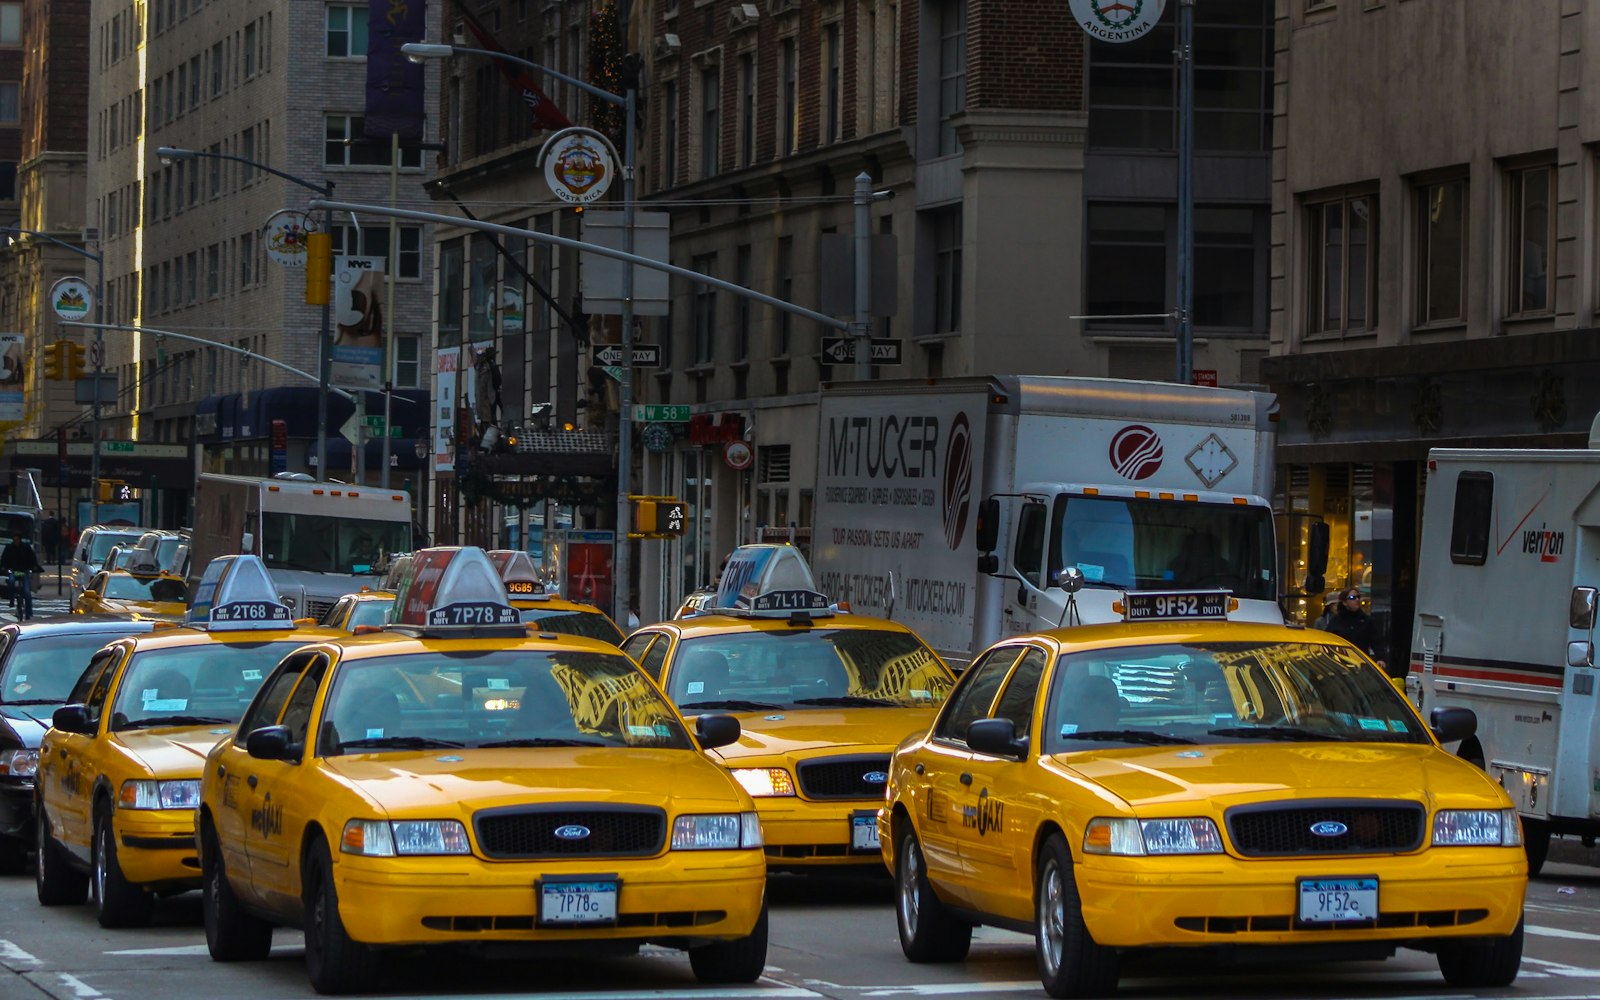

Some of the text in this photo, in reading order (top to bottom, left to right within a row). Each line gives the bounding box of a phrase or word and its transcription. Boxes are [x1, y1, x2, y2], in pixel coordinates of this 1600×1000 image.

[1083, 20, 1151, 40] ARGENTINA
[555, 188, 602, 202] COSTA RICA
[347, 260, 373, 268] NYC
[603, 352, 651, 360] ONE WAY
[833, 345, 856, 356] ONE
[646, 408, 656, 419] W
[662, 408, 678, 420] 58
[847, 528, 873, 547] PASSION
[874, 530, 890, 548] SETS
[891, 531, 901, 549] US
[1522, 522, 1565, 563] verizon
[509, 582, 533, 593] 9G85
[773, 593, 806, 608] 7L11
[1133, 598, 1149, 606] OFF
[1155, 595, 1199, 616] 9F52
[1205, 596, 1219, 604] OFF
[232, 604, 267, 619] 2T68
[452, 607, 495, 624] 7P78
[1131, 607, 1151, 616] DUTY
[1202, 606, 1223, 615] DUTY
[433, 617, 449, 625] DUTY
[499, 615, 515, 623] DUTY
